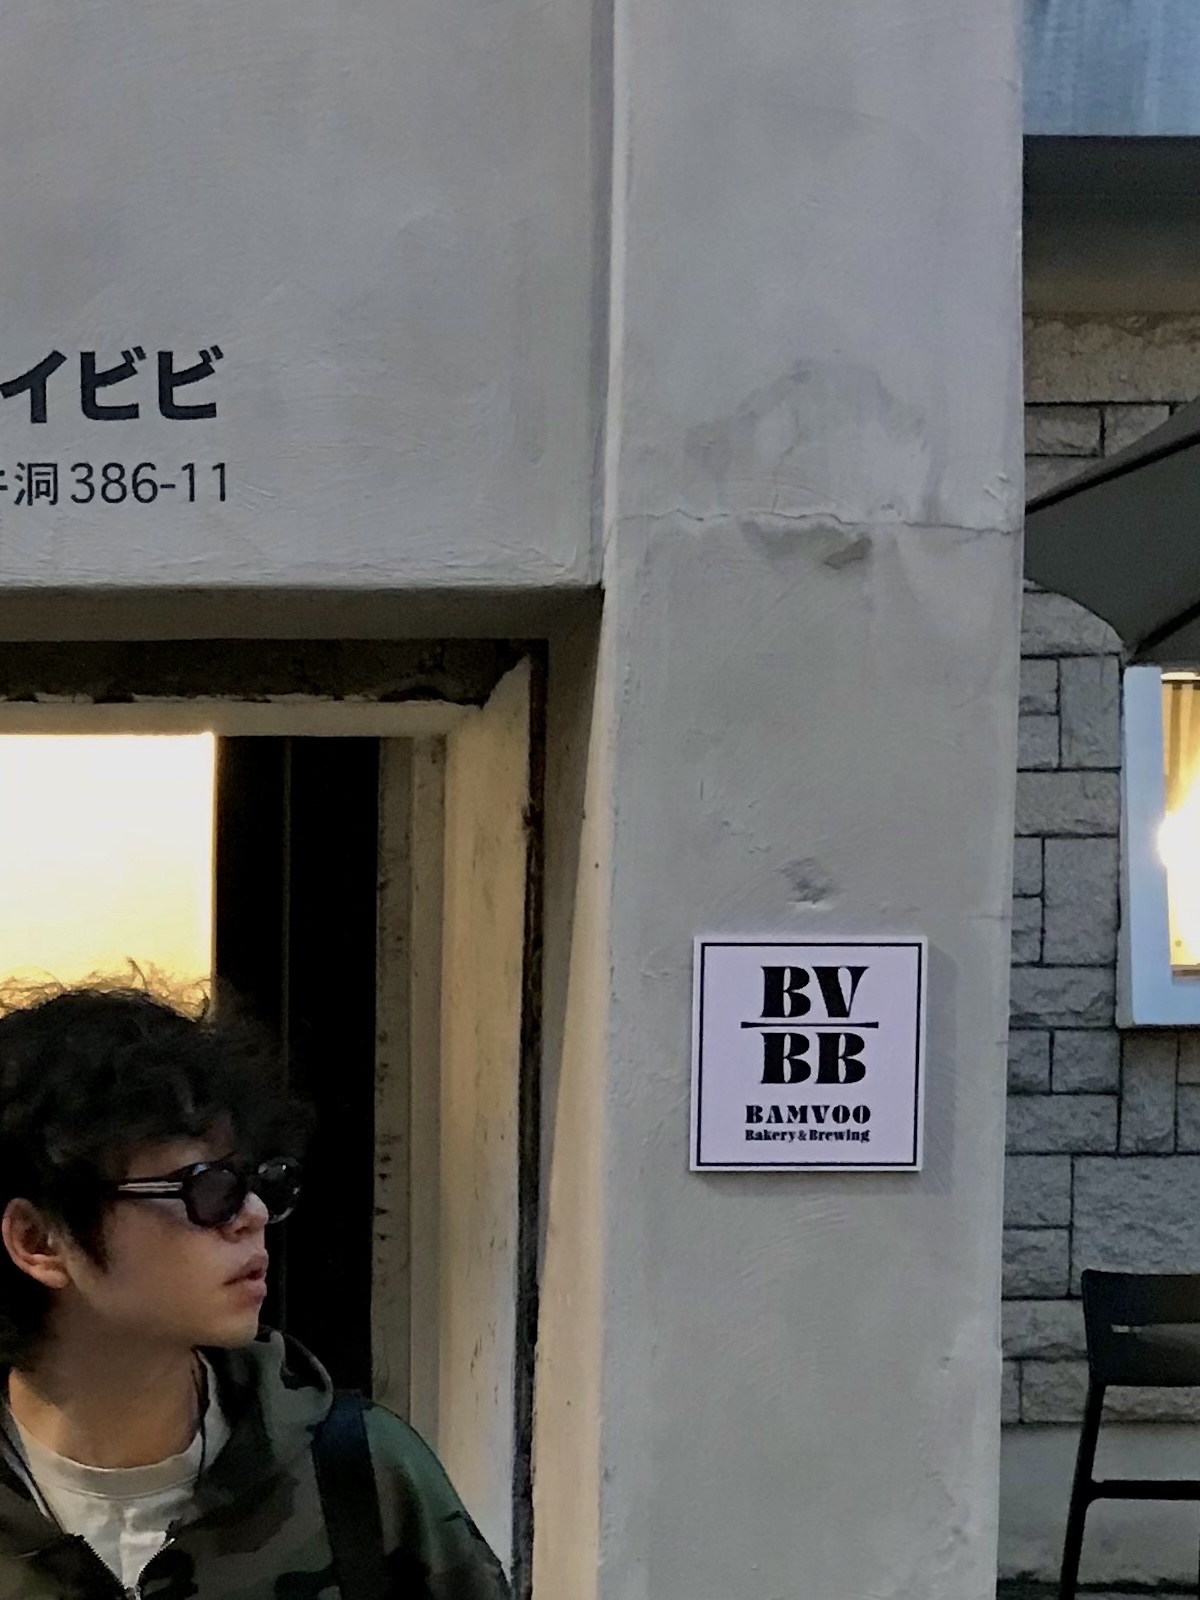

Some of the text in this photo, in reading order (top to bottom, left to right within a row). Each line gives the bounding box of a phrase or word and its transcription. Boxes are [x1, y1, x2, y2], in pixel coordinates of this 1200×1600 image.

[760, 965, 869, 1018] BV
[760, 1032, 866, 1085] BB
[745, 1104, 871, 1124] BAMVOO
